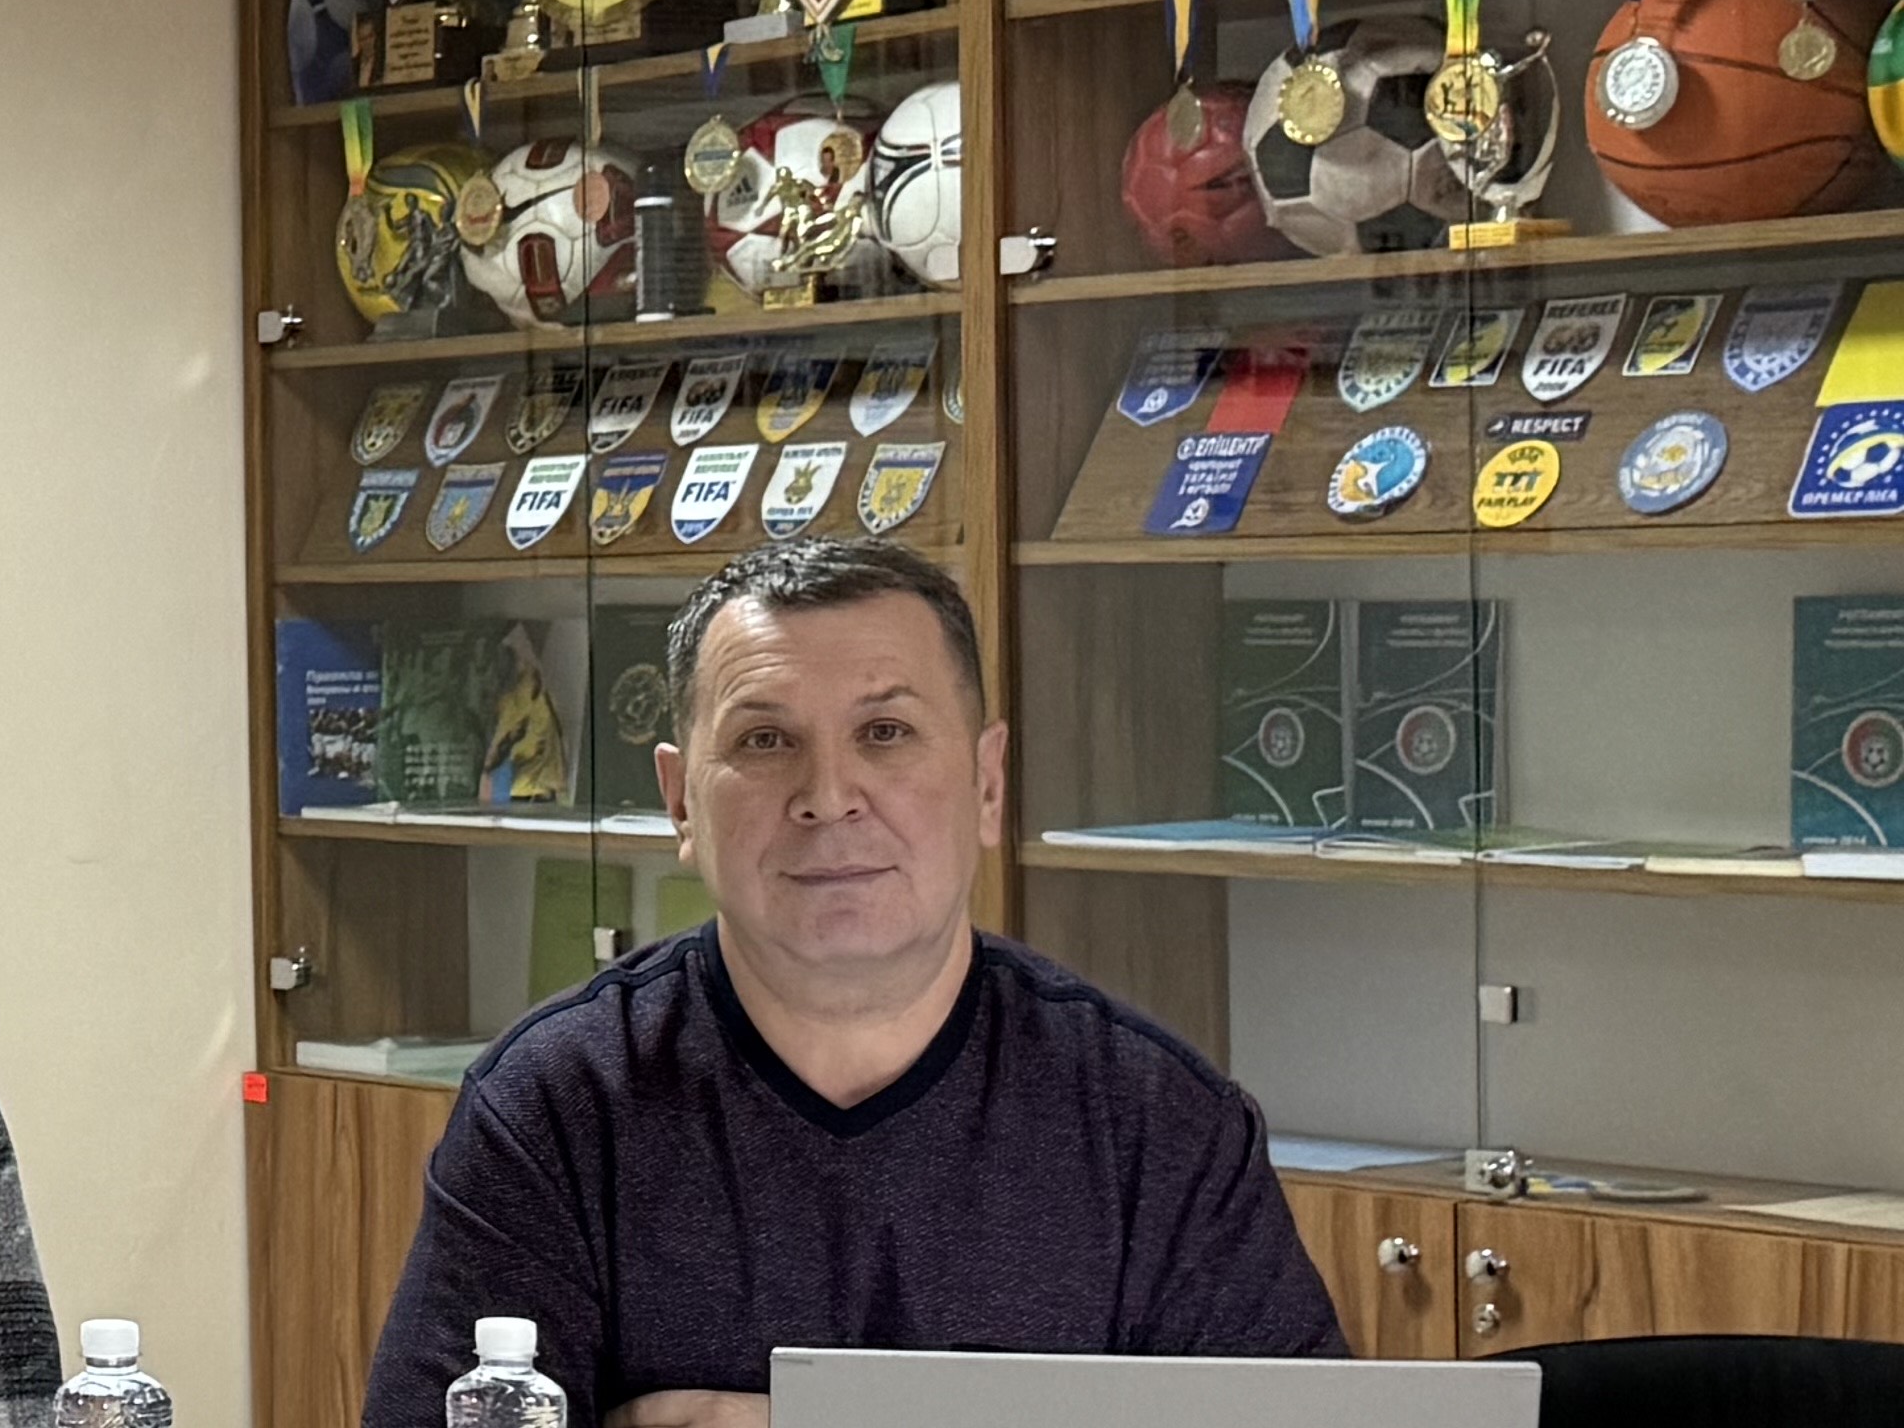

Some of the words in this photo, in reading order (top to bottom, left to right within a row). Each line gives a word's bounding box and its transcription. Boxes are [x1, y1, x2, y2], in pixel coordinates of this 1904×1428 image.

[1533, 358, 1586, 376] FIFA
[597, 396, 644, 415] FIFA
[678, 409, 715, 425] FIFA
[1510, 416, 1584, 435] RESPECT
[515, 490, 564, 512] FIFA
[682, 481, 732, 503] FIFA
